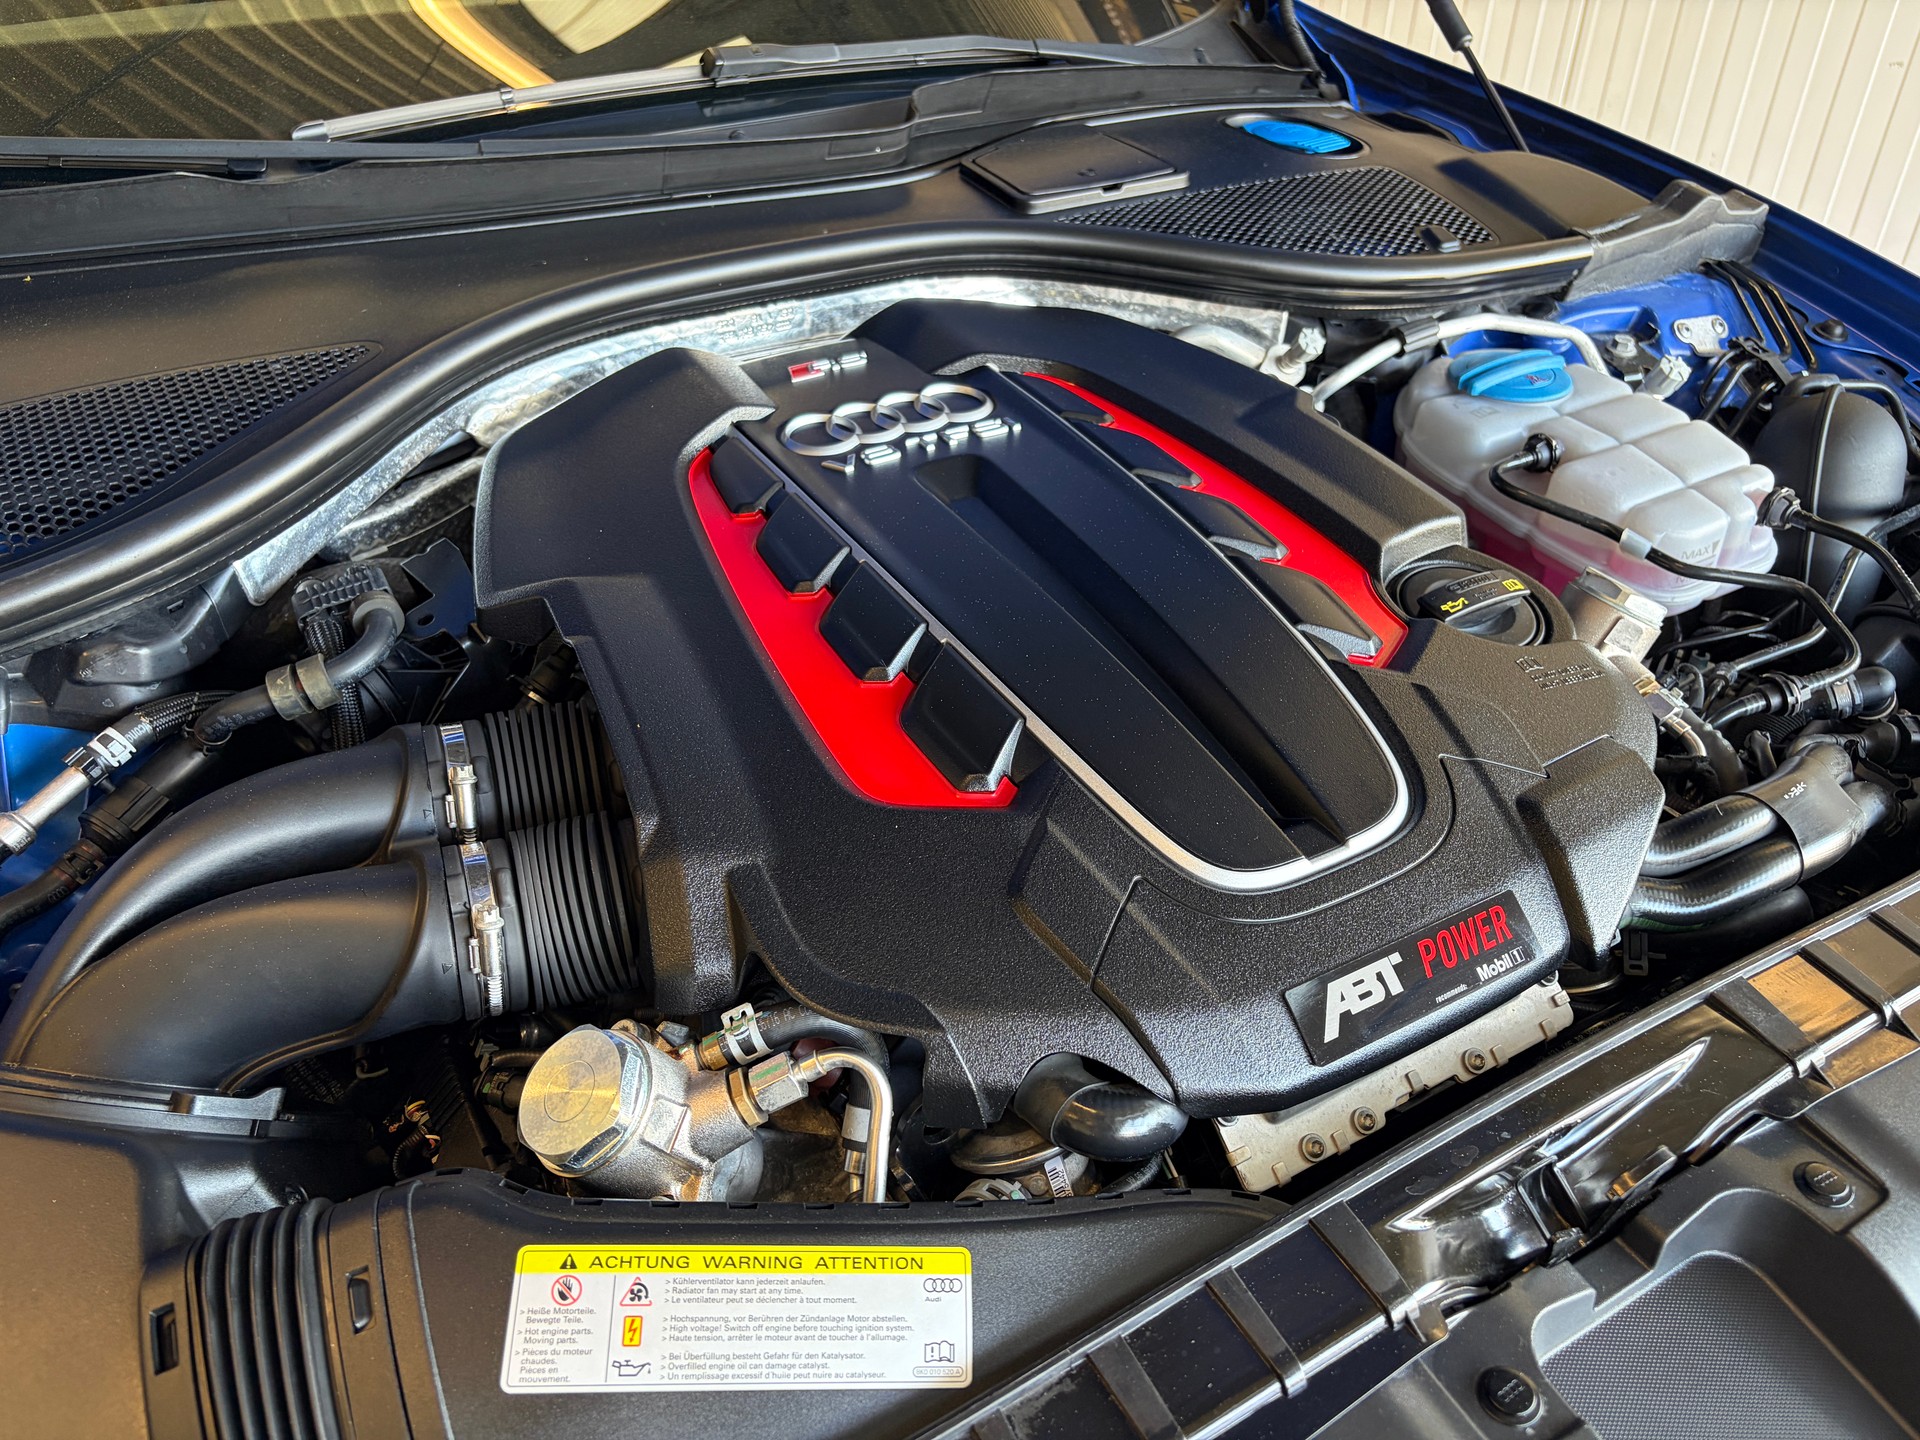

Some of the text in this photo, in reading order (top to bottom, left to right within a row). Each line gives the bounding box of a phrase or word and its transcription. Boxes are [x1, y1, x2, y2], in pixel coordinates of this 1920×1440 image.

[1476, 953, 1514, 982] Mobil
[1324, 905, 1513, 1043] ABT POWER
[588, 1255, 923, 1270] ACHTUNG WARNING ATTENTION
[672, 1277, 826, 1287] Kühlerventilator kann jederzeit anlaufen.
[671, 1285, 804, 1296] Radiator fan may start at any time.
[671, 1295, 681, 1304] Le
[682, 1295, 725, 1304] ventilateur
[725, 1295, 744, 1305] peut
[755, 1295, 798, 1304] déclencher
[552, 1307, 597, 1315] Motorteile.
[525, 1315, 584, 1325] Bewegte Teile.
[669, 1314, 732, 1324] Hochspannung,
[747, 1314, 784, 1323] Berühren
[785, 1314, 799, 1323] der
[799, 1314, 846, 1324] Zündanlage
[846, 1314, 870, 1323] Motor
[871, 1315, 908, 1323] abstellen.
[524, 1327, 594, 1336] Hot engine parts.
[669, 1324, 689, 1333] High
[723, 1323, 751, 1332] Switch
[752, 1323, 764, 1332] off
[764, 1324, 792, 1333] engine
[793, 1323, 819, 1332] before
[819, 1324, 854, 1333] touching
[854, 1324, 884, 1333] ignition
[885, 1325, 915, 1333] system.
[523, 1336, 579, 1345] Moving parts.
[668, 1332, 693, 1342] Haute
[693, 1332, 726, 1342] tension,
[727, 1333, 754, 1342] arrêter
[755, 1333, 763, 1342] le
[764, 1332, 793, 1342] moteur
[817, 1333, 828, 1341] de
[828, 1332, 858, 1341] toucher
[549, 1347, 562, 1356] du
[562, 1348, 593, 1356] moteur
[668, 1352, 682, 1361] Bei
[732, 1351, 762, 1361] besteht
[763, 1351, 790, 1360] Gefahr
[791, 1351, 803, 1360] für
[804, 1352, 819, 1360] den
[821, 1351, 866, 1361] Katalysator.
[520, 1356, 558, 1365] chaudes.
[667, 1361, 707, 1371] Overfilled
[708, 1361, 736, 1371] engine
[737, 1362, 748, 1370] oil
[764, 1361, 797, 1371] damage
[798, 1361, 830, 1371] catalyst.
[518, 1375, 571, 1383] mouvement.
[667, 1372, 680, 1381] Un
[681, 1371, 730, 1381] remplissage
[731, 1371, 763, 1380] excessif
[792, 1372, 811, 1380] peut
[812, 1370, 833, 1379] nuire
[845, 1370, 887, 1380] catalyseur.
